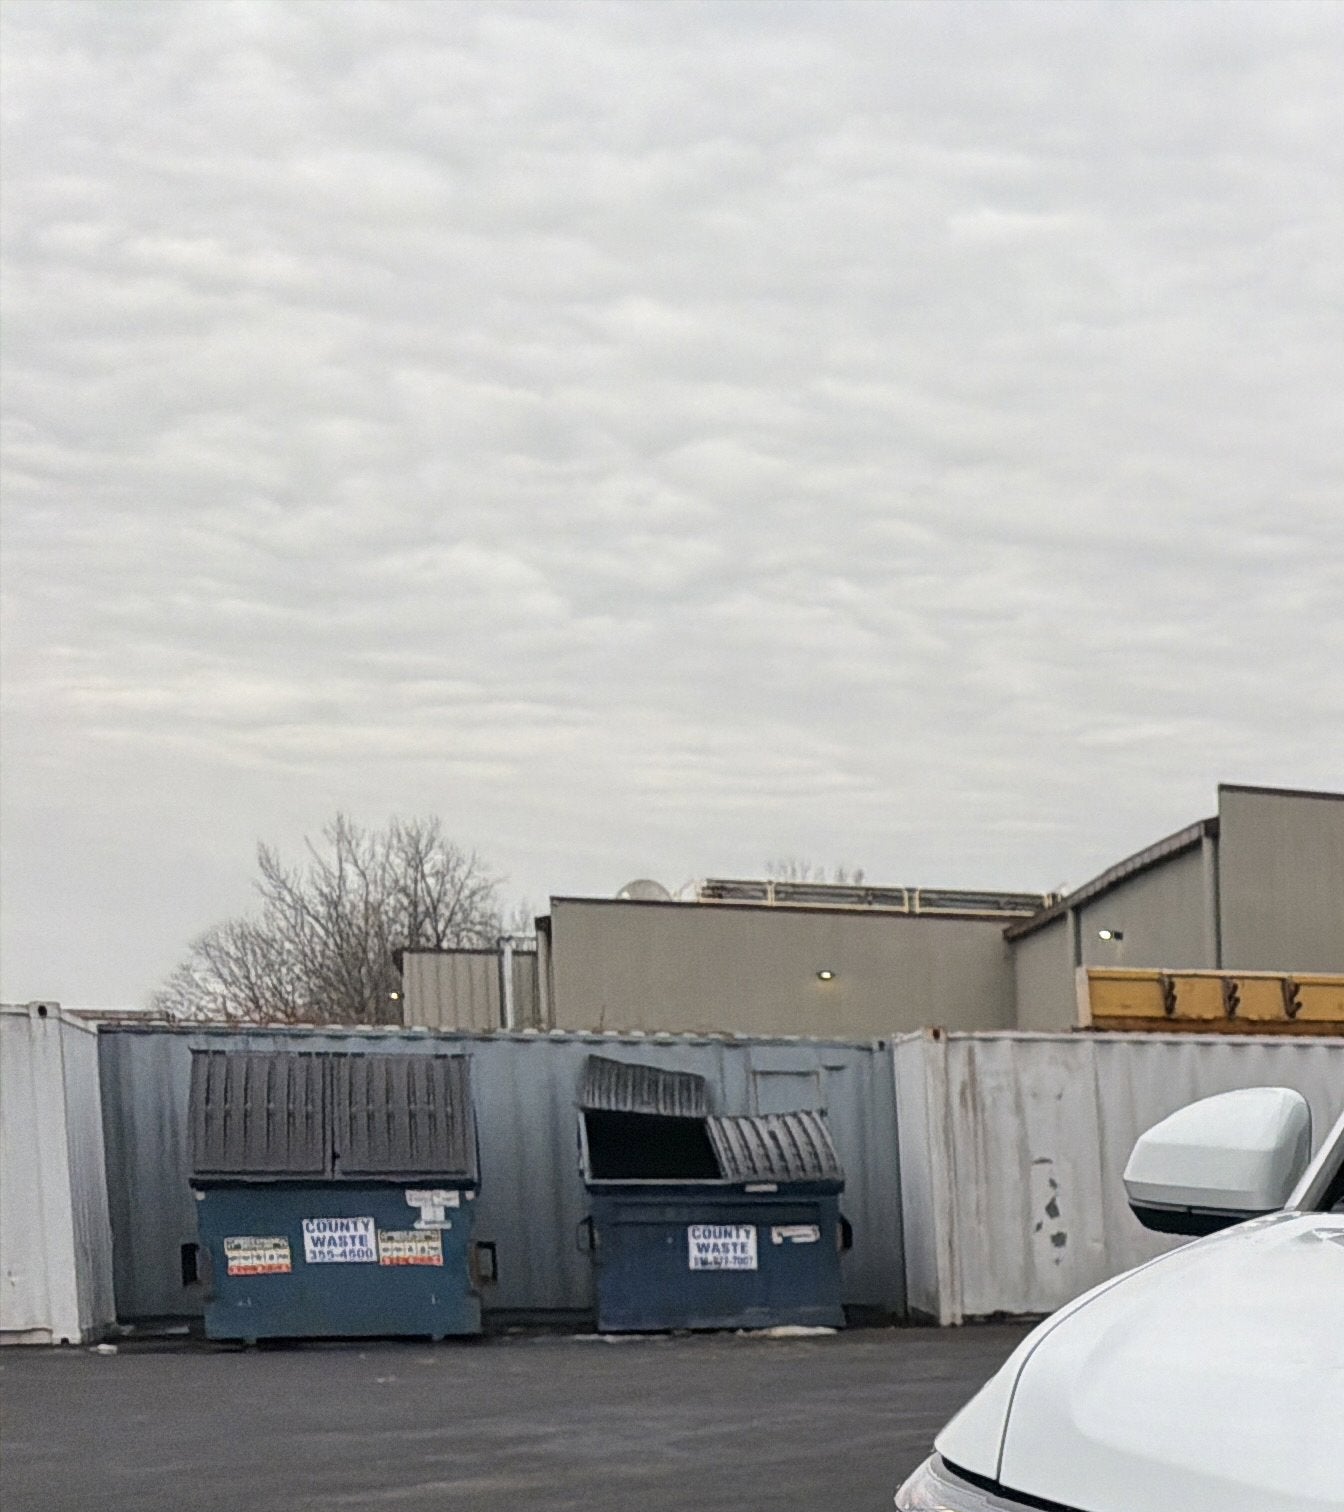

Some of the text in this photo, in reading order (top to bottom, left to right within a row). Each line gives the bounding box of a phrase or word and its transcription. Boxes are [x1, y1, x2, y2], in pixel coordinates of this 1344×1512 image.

[305, 1218, 371, 1234] COUNTY
[692, 1225, 751, 1240] COUNTY
[311, 1234, 369, 1248] WASTE
[696, 1242, 749, 1255] WASTE
